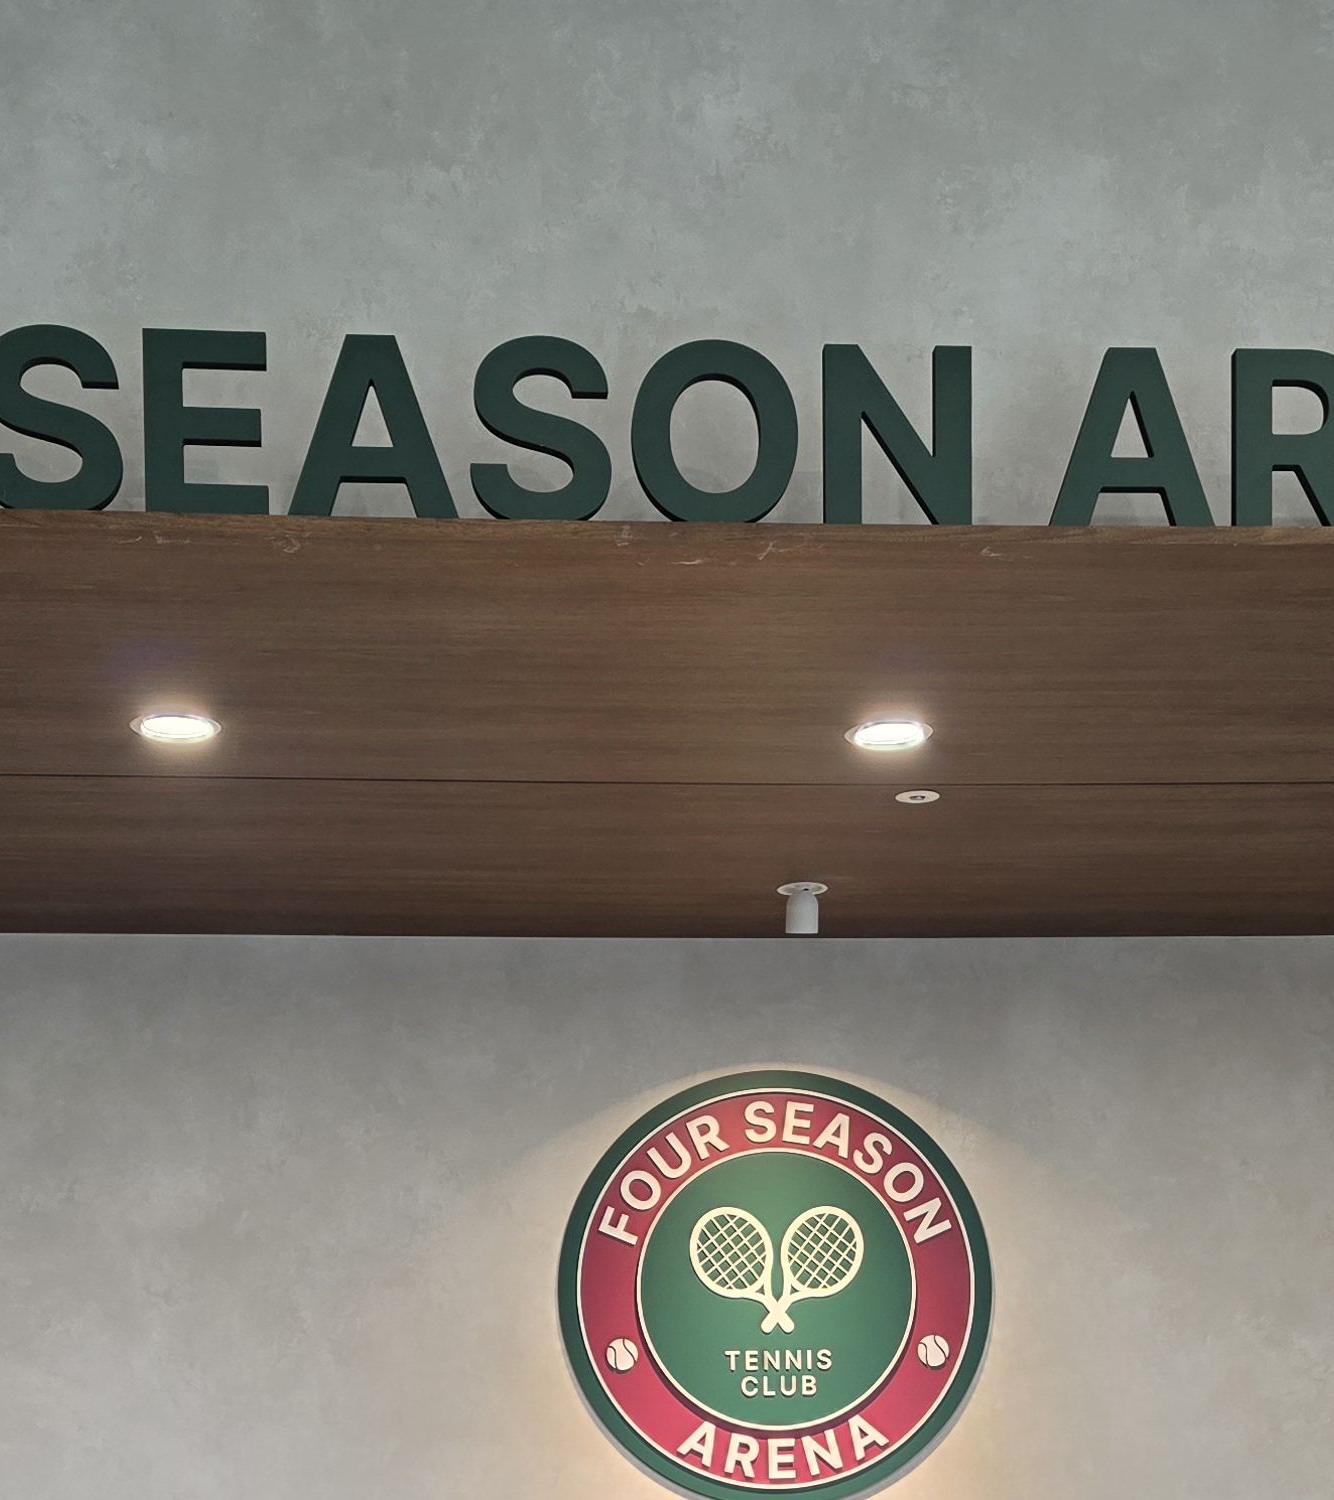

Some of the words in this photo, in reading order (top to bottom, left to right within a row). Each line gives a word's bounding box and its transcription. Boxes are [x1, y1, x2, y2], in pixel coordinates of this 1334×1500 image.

[598, 1114, 730, 1246] FOUR
[744, 1100, 952, 1244] SEASON
[724, 1348, 833, 1371] TENNIS
[741, 1376, 817, 1397] CLUB
[676, 1415, 889, 1480] ARENA
